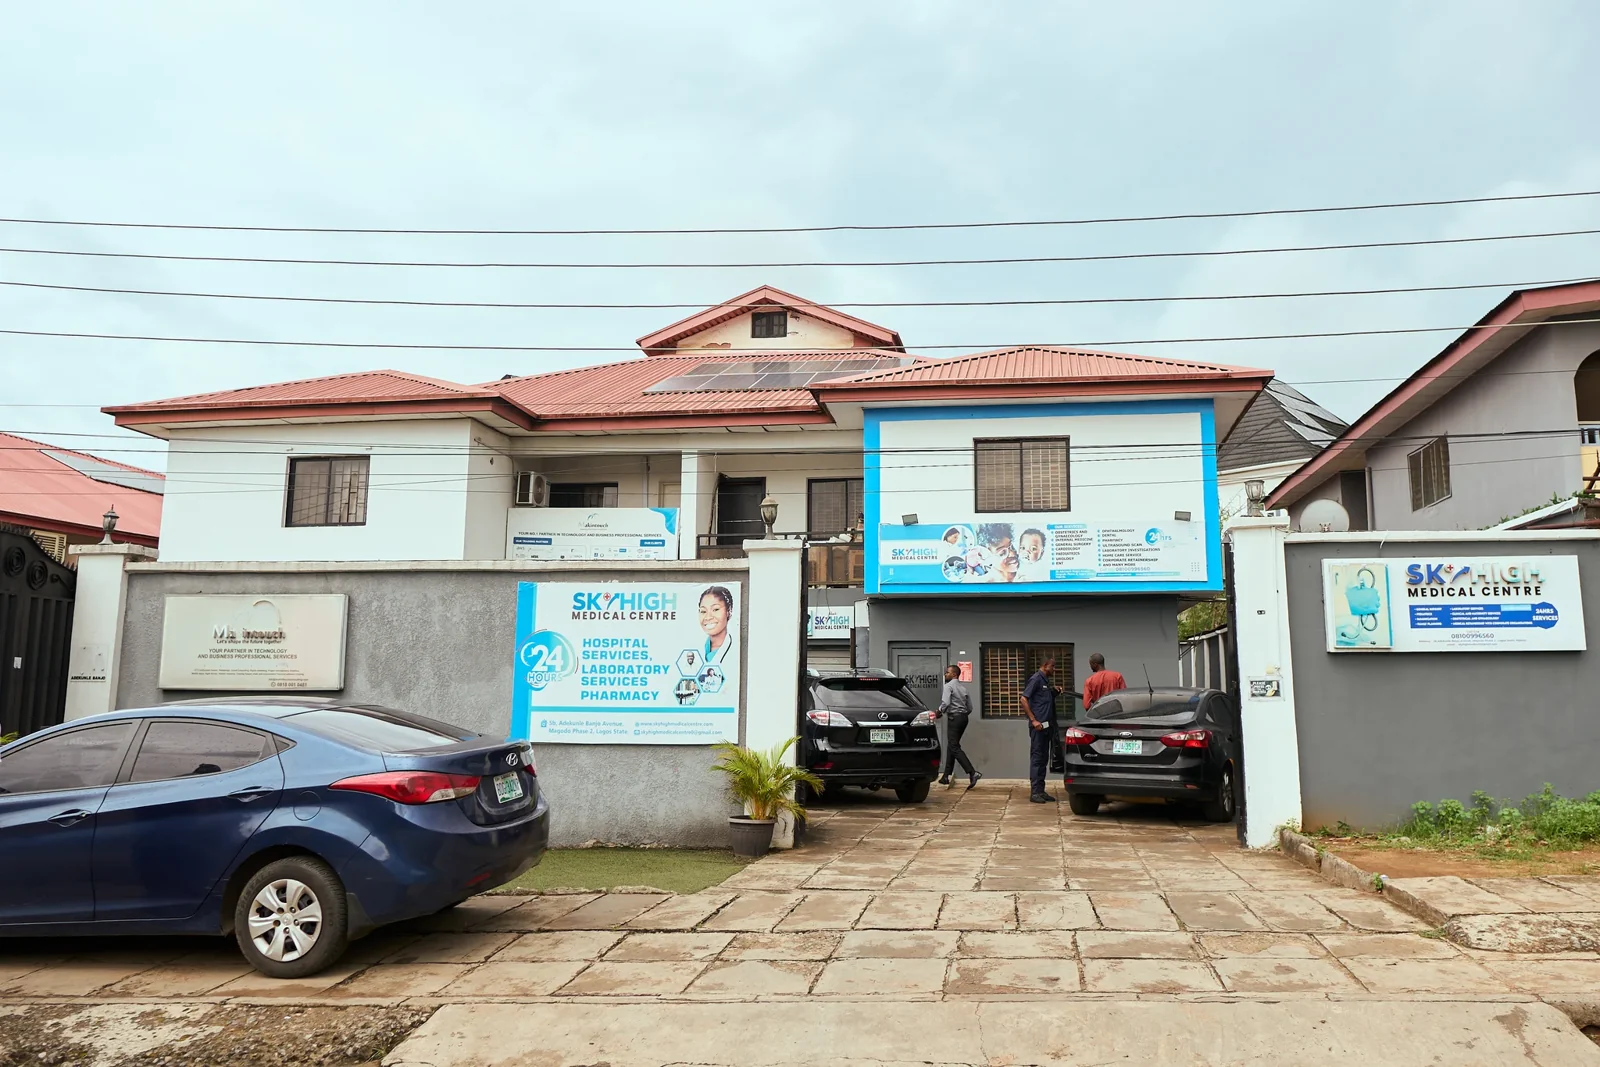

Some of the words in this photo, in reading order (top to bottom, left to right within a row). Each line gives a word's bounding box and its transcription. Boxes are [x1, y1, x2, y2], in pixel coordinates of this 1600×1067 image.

[1408, 587, 1475, 597] MEDICAL
[1482, 586, 1542, 596] CENTRE
[572, 592, 677, 610] SKYHIGH
[572, 612, 625, 620] MEDICAL
[630, 612, 676, 620] CENTRE
[583, 638, 648, 648] HOSPITAL
[532, 644, 563, 671] 24
[582, 650, 652, 661] SERVICES,
[582, 665, 670, 674] LABORATORY
[529, 673, 562, 682] HOURS
[581, 677, 648, 686] SERVICES
[581, 691, 659, 700] PHARMACY
